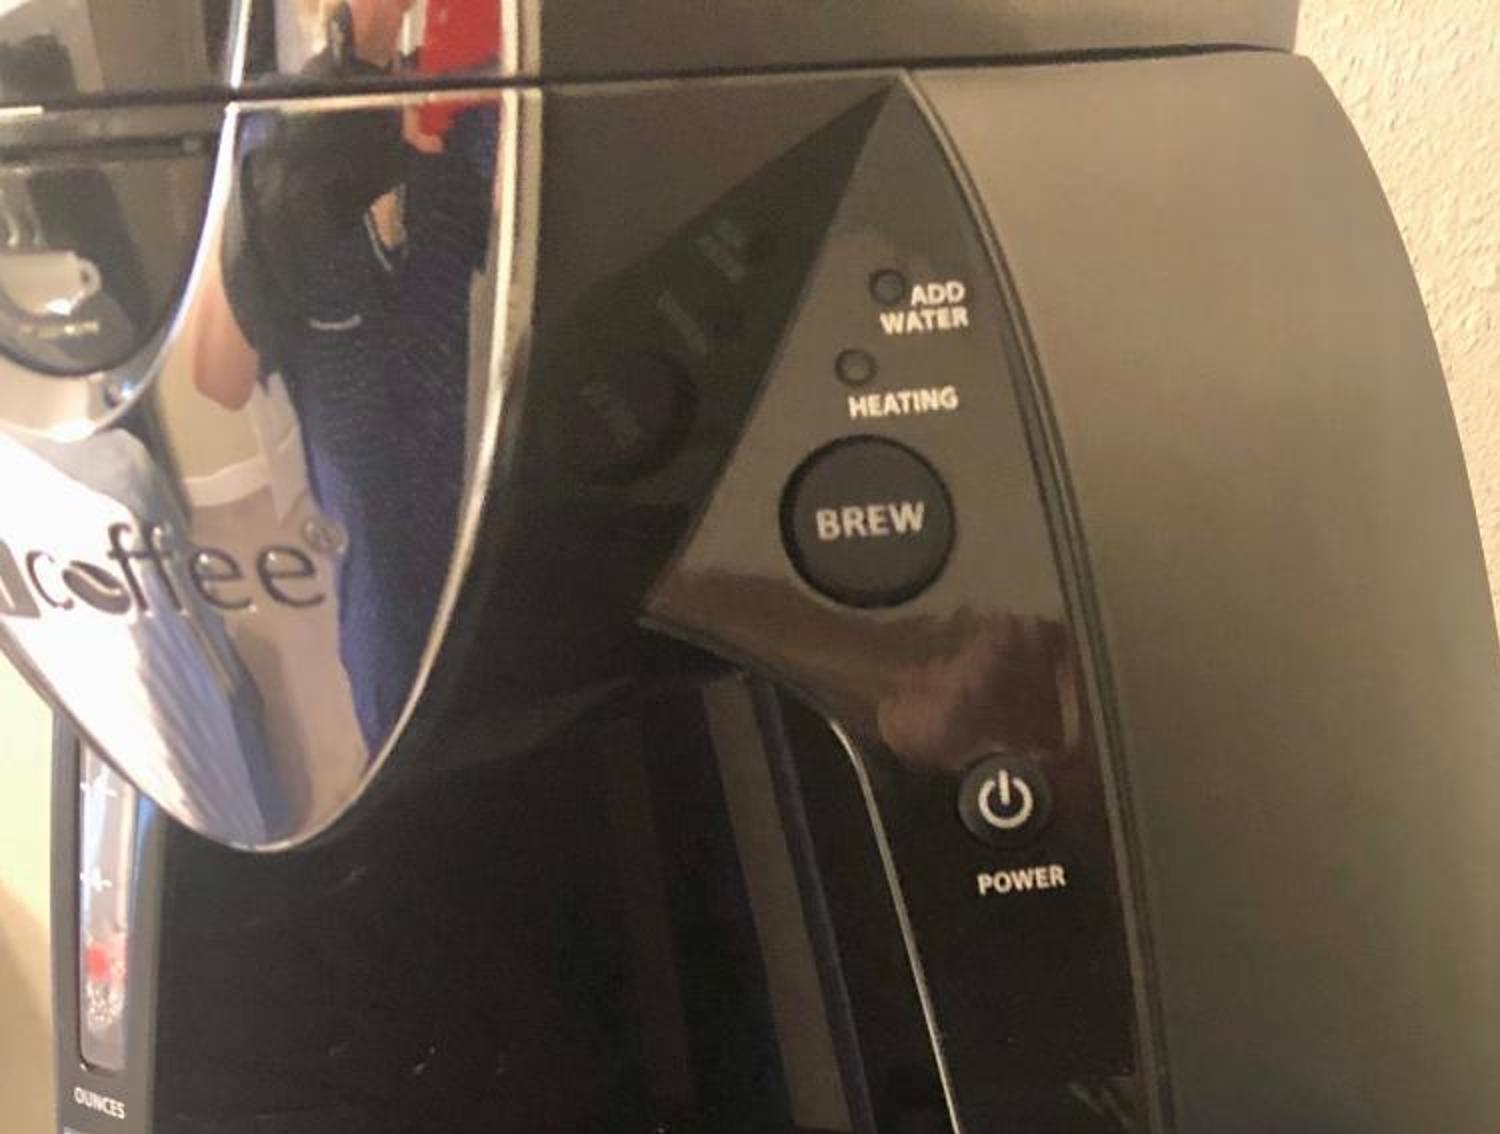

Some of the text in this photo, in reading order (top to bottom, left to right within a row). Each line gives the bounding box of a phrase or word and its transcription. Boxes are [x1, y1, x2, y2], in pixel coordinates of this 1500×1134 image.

[910, 282, 965, 306] ADD
[880, 307, 968, 335] WATER
[848, 387, 958, 419] HEATING
[815, 502, 925, 540] BREW
[977, 864, 1066, 896] POWER
[74, 1087, 125, 1119] OUNCES
